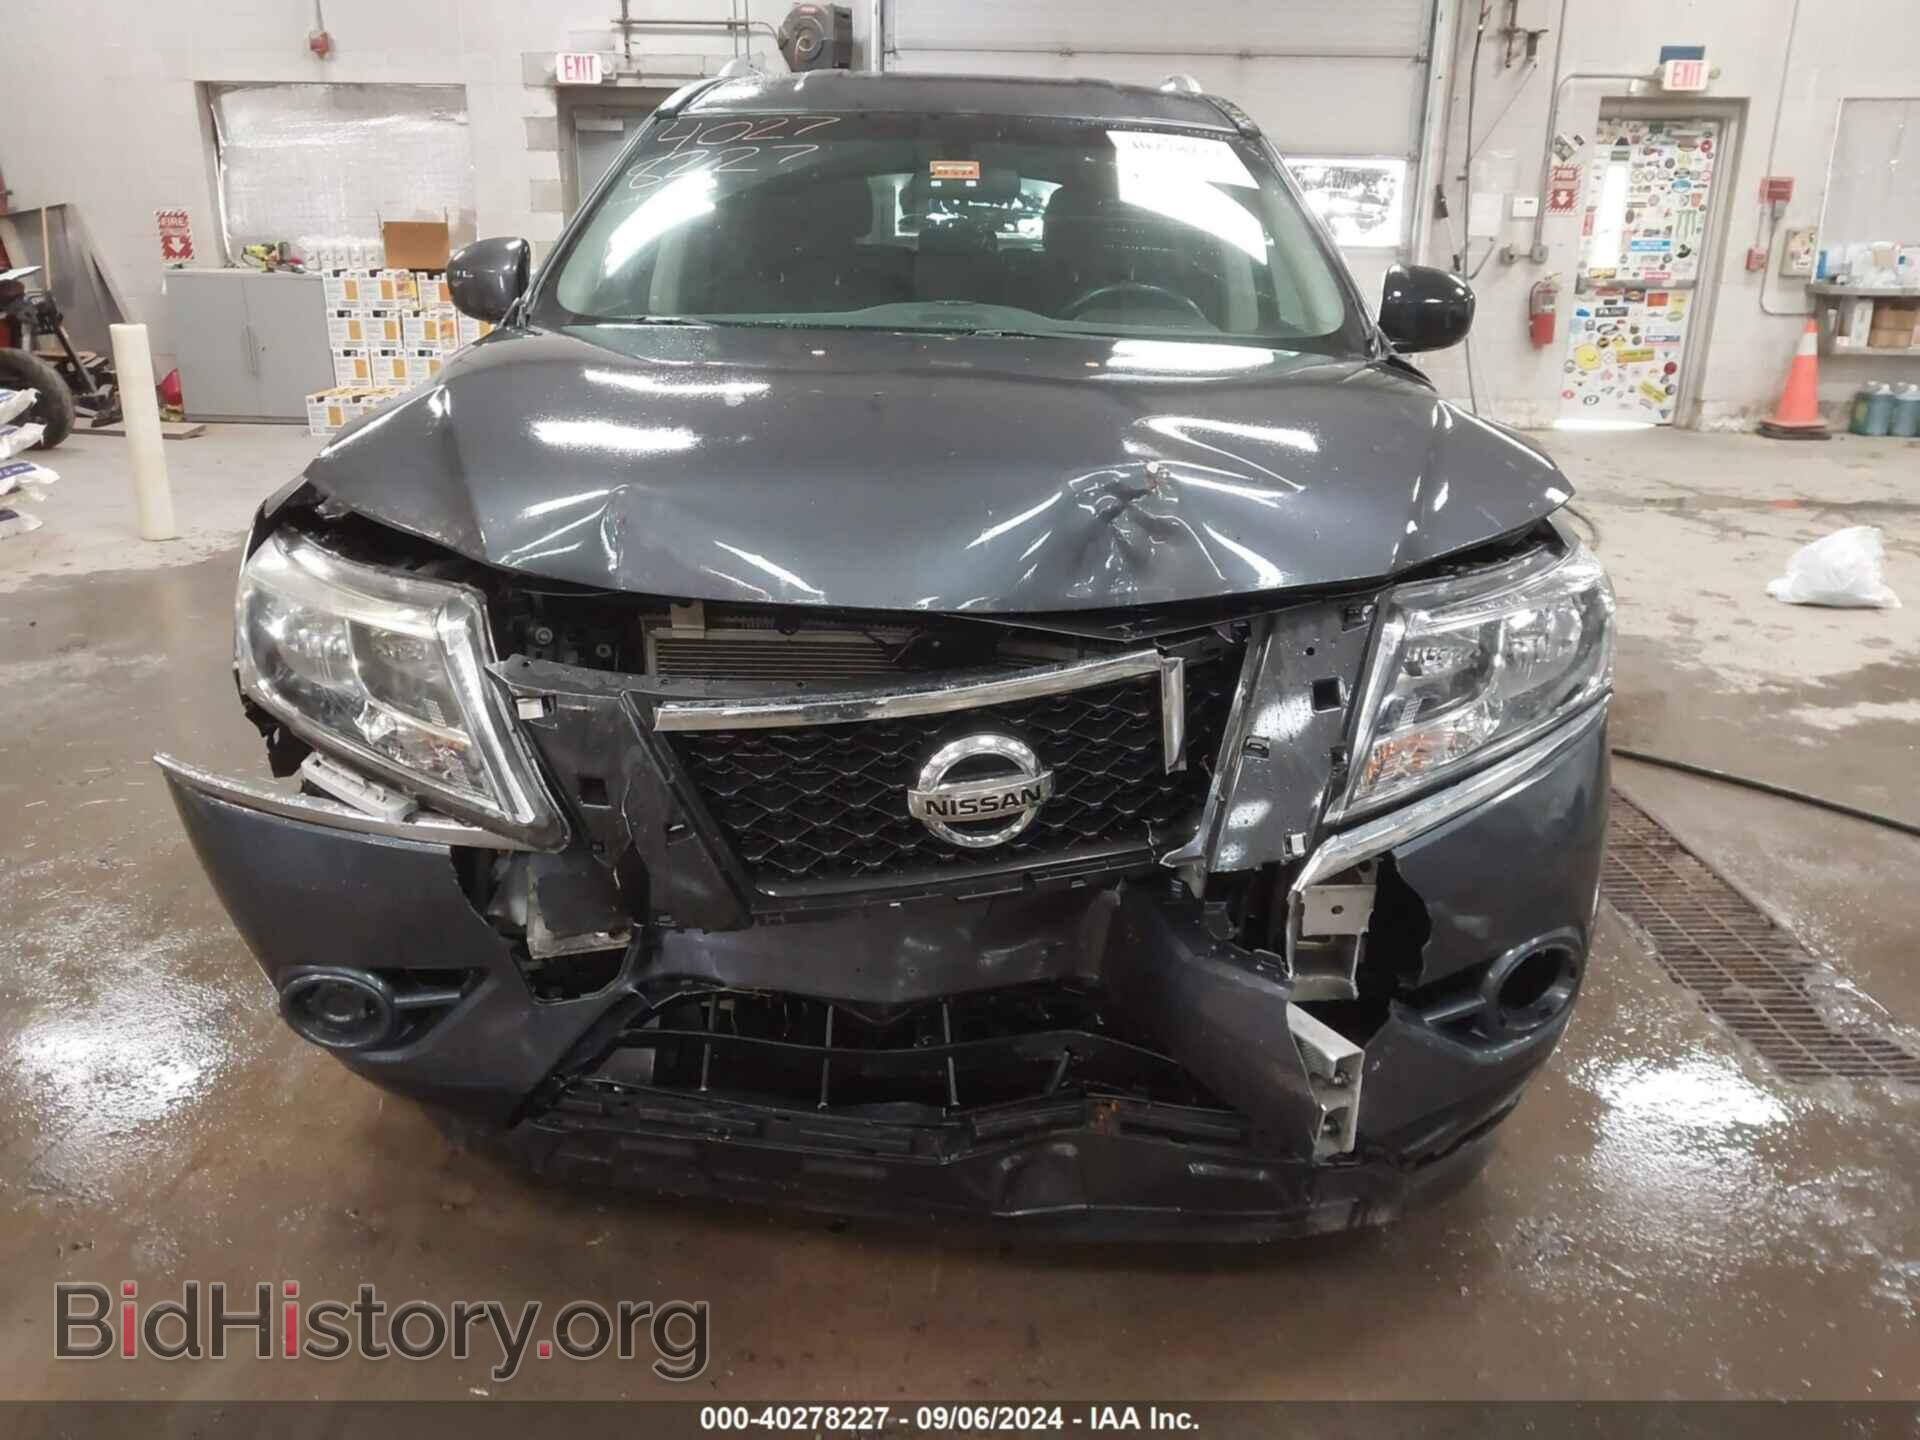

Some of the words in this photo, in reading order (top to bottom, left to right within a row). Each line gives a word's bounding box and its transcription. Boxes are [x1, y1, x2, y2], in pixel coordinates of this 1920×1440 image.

[564, 55, 594, 81] EXIT
[1672, 62, 1703, 88] EXIT
[657, 115, 841, 153] 4027
[925, 785, 1041, 815] NISSAN
